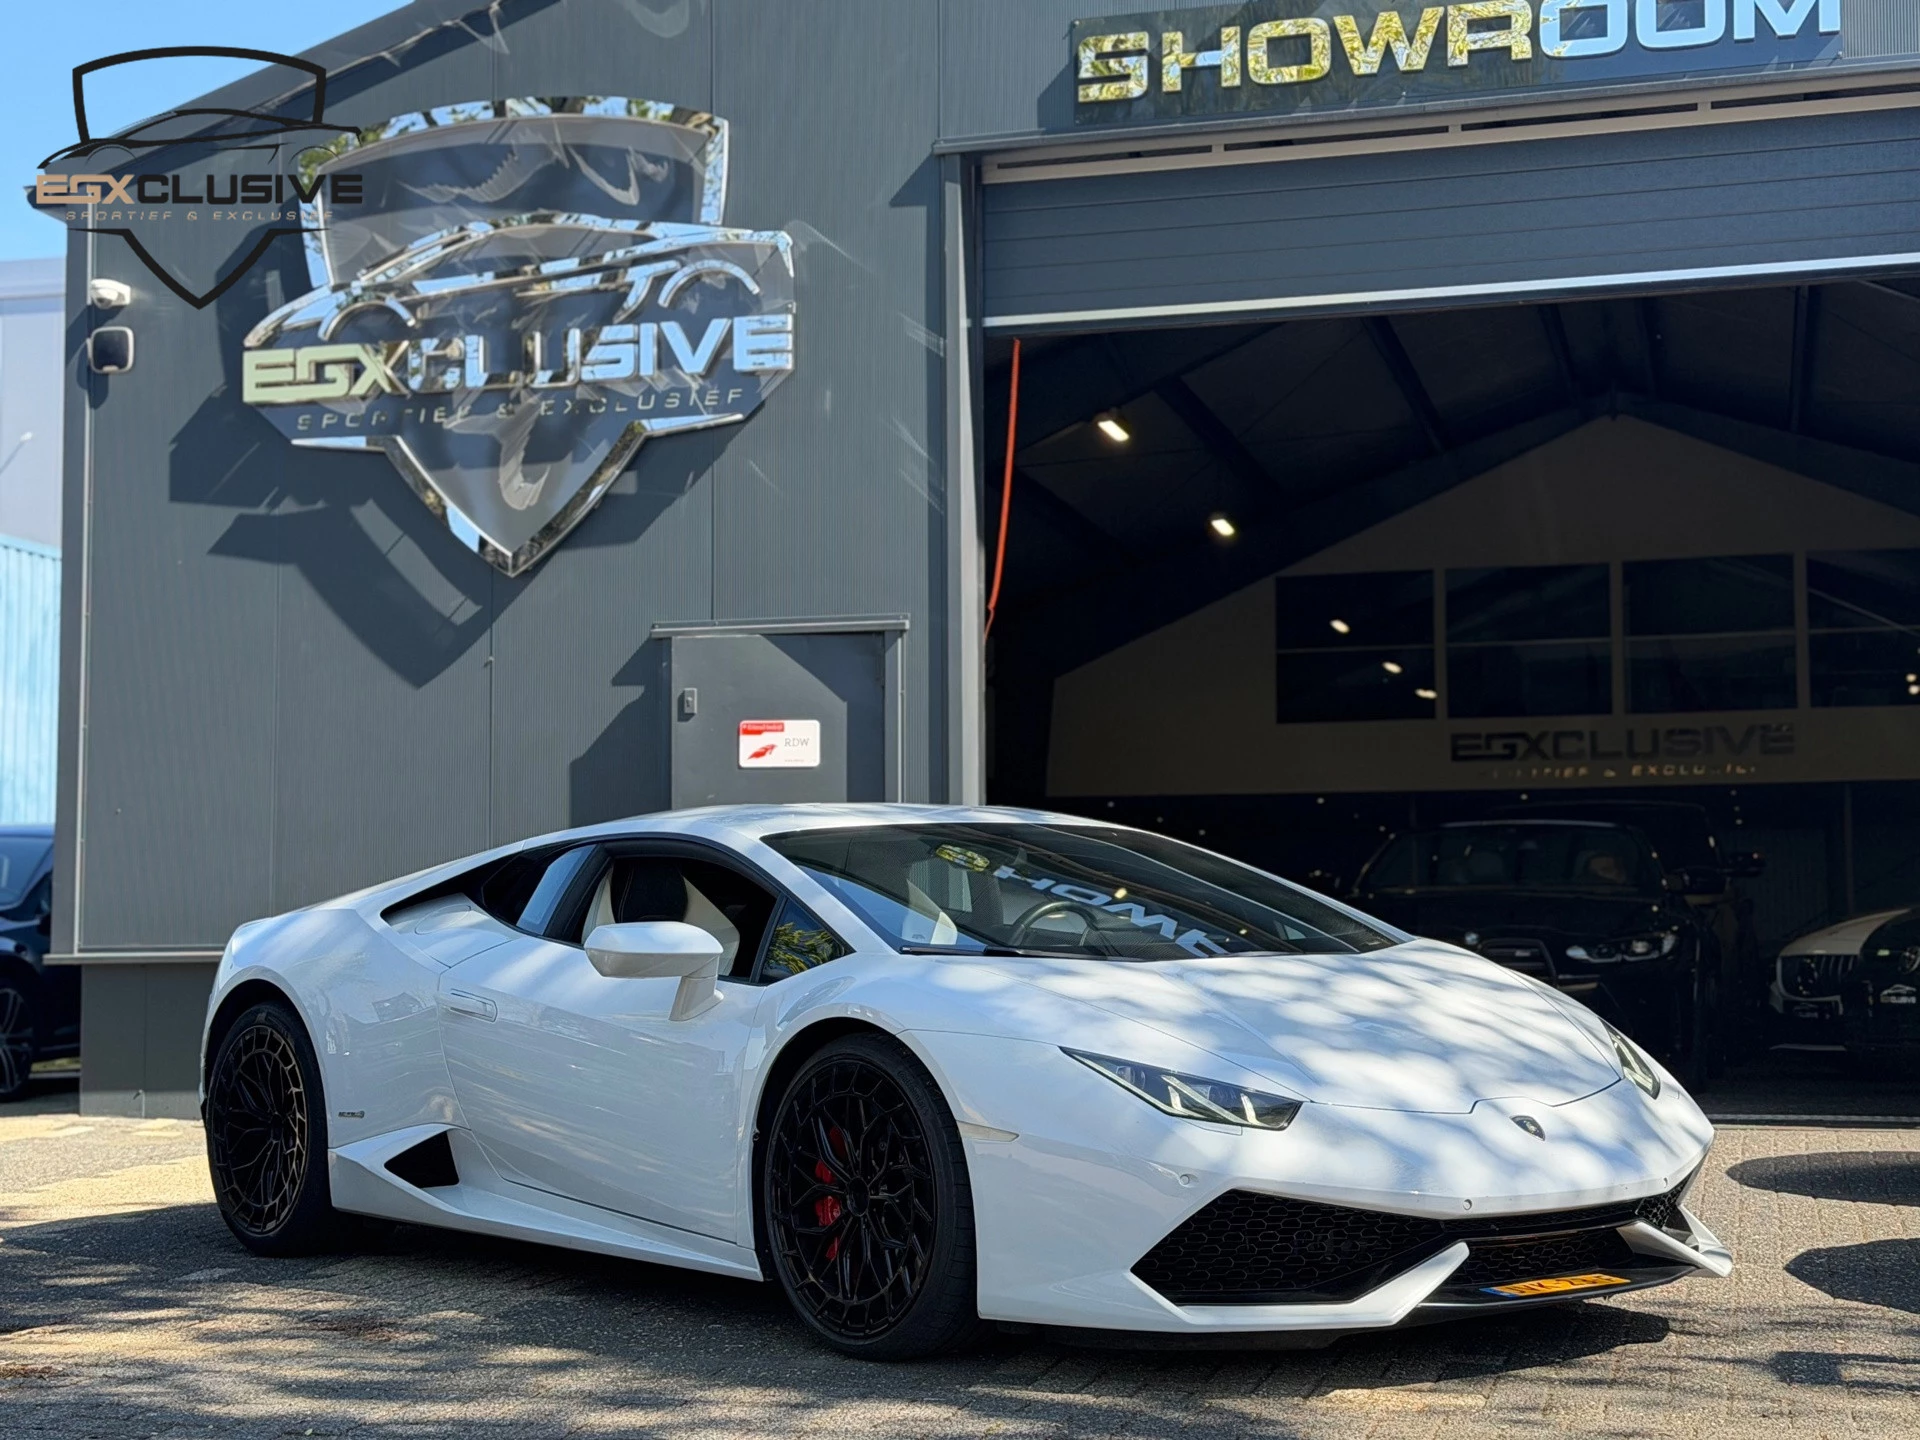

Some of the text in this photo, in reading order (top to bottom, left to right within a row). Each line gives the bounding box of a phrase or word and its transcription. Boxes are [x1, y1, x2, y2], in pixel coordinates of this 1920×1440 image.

[1078, 0, 1841, 103] SHOWROOM
[243, 313, 795, 402] EGXCLUSIVE
[784, 737, 810, 747] RDW
[1451, 723, 1795, 762] EGXCLUSIVE
